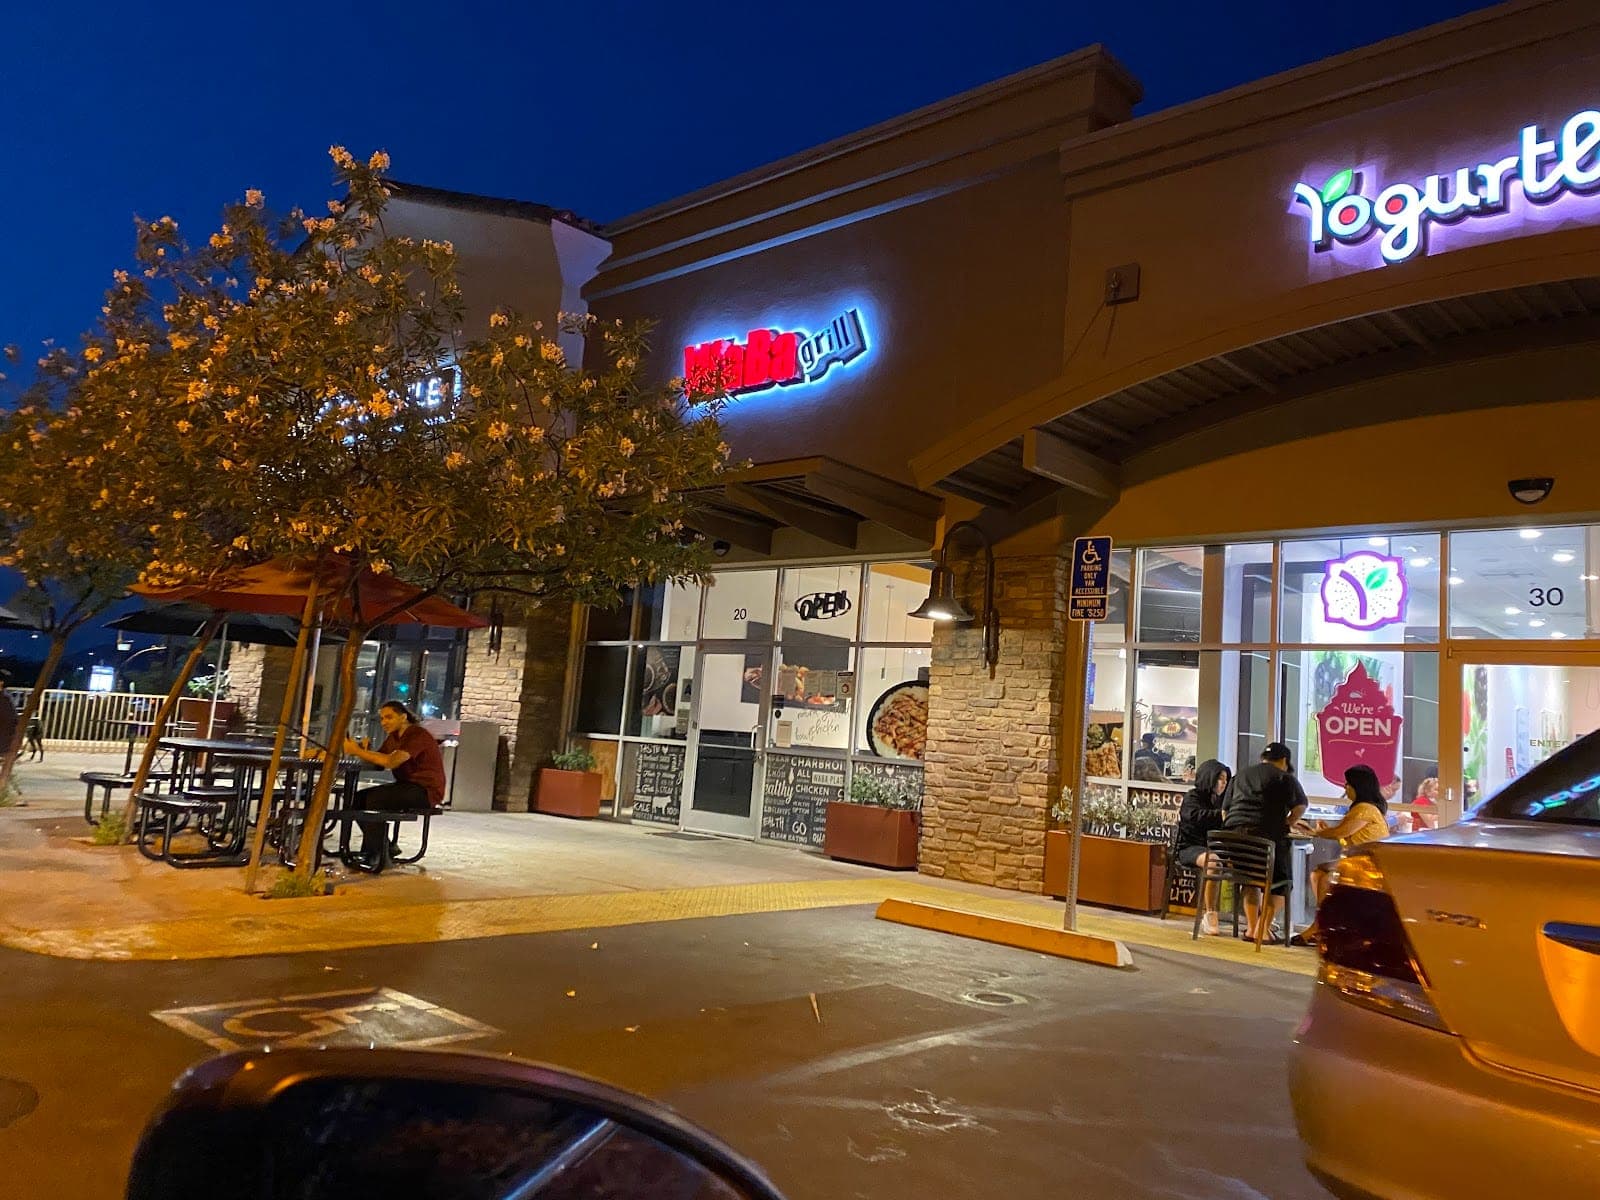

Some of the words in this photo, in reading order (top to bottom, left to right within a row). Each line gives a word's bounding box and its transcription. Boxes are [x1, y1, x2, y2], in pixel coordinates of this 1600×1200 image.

[799, 309, 853, 376] grill
[1080, 564, 1103, 572] PARKING
[1083, 572, 1097, 580] ONLY
[1074, 587, 1105, 595] ACCESSIBLE
[1529, 587, 1564, 607] 30
[800, 590, 848, 621] OPEN
[1076, 599, 1102, 608] MINIMUM
[733, 608, 747, 621] 20
[1072, 608, 1085, 618] FINE
[1341, 702, 1375, 715] We're
[1325, 716, 1393, 738] OPEN
[797, 768, 811, 778] ALL
[795, 784, 830, 796] CHICKEN
[792, 821, 807, 835] GO
